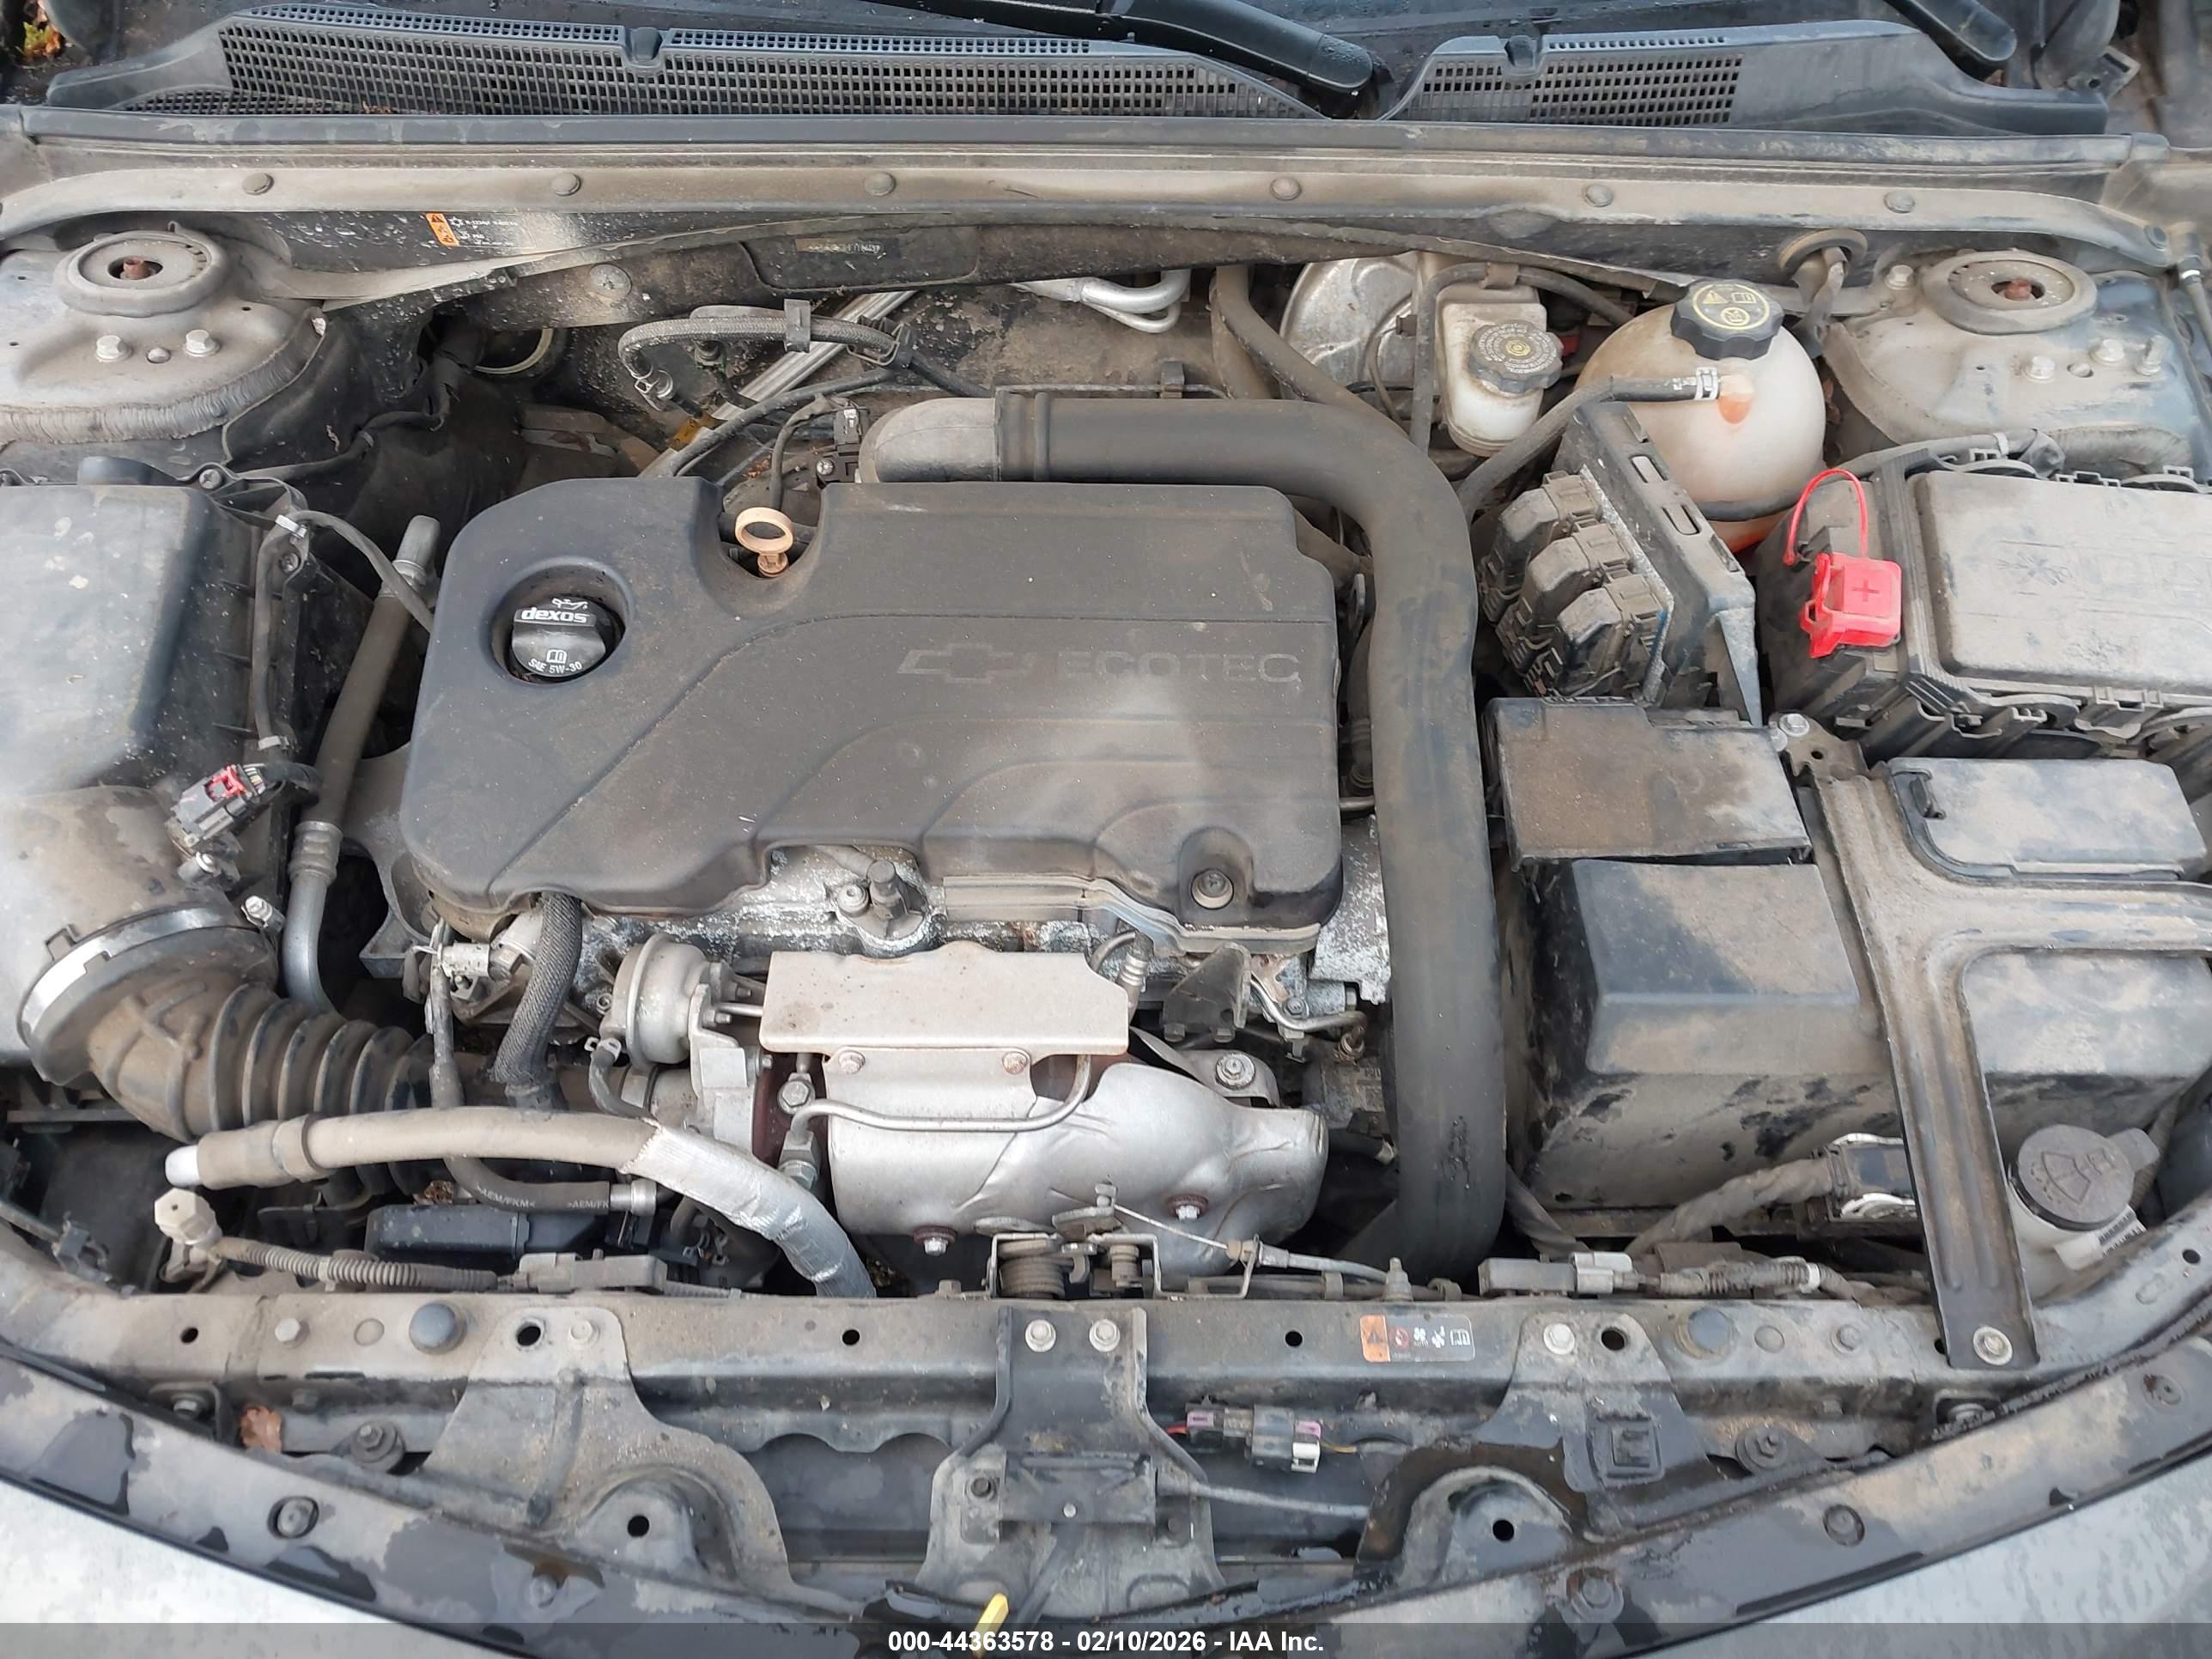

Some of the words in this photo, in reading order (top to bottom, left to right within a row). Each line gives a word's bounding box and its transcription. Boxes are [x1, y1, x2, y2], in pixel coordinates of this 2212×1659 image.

[521, 606, 591, 623] dexos
[528, 658, 547, 672] SAE
[549, 661, 583, 674] 5W-30
[1058, 651, 1299, 684] ECOTEC
